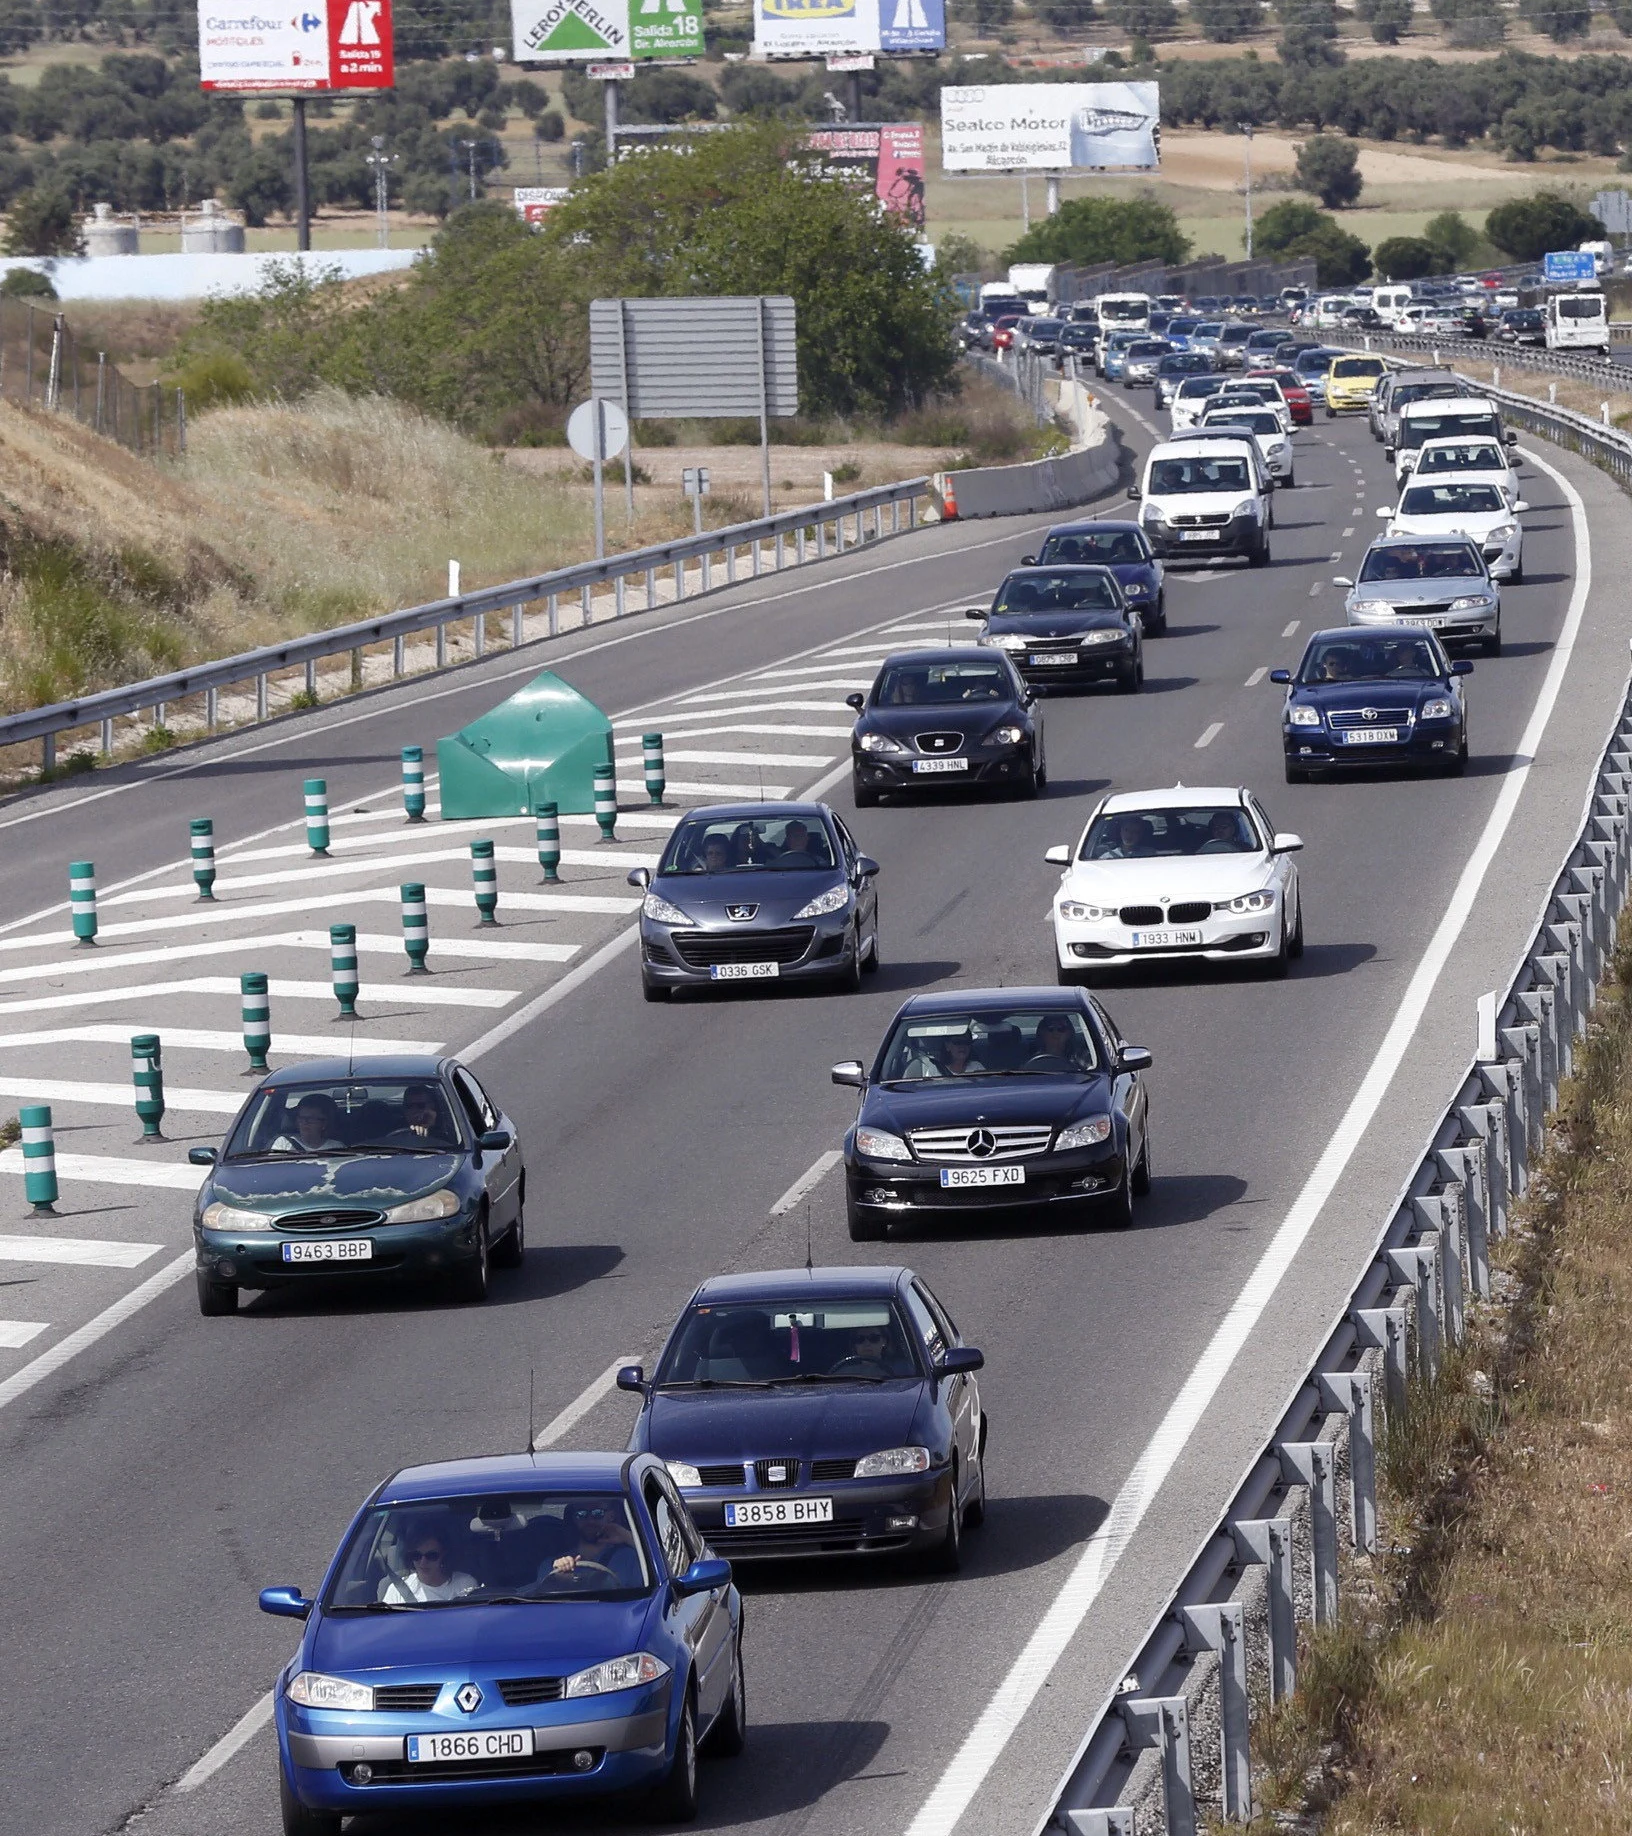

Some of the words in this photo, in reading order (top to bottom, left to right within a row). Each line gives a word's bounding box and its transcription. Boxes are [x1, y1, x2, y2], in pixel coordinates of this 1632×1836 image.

[206, 16, 283, 31] Carrefour
[523, 0, 567, 49] LEROY
[632, 25, 673, 37] Salida
[672, 15, 699, 36] 18
[944, 118, 1005, 132] Sealco
[1011, 117, 1067, 131] Motor
[920, 762, 945, 771] 4339
[947, 760, 965, 770] HNL
[1142, 932, 1169, 946] 1933
[1175, 931, 1197, 943] HNM
[720, 965, 748, 978] 0336
[752, 964, 773, 976] GSK
[951, 1169, 988, 1185] 9625
[993, 1167, 1020, 1183] FXD
[293, 1243, 333, 1260] 9463
[338, 1242, 368, 1259] BBP
[737, 1504, 787, 1523] 3858
[794, 1501, 830, 1520] BHY
[429, 1735, 480, 1759] 1866
[485, 1733, 524, 1755] CHD
